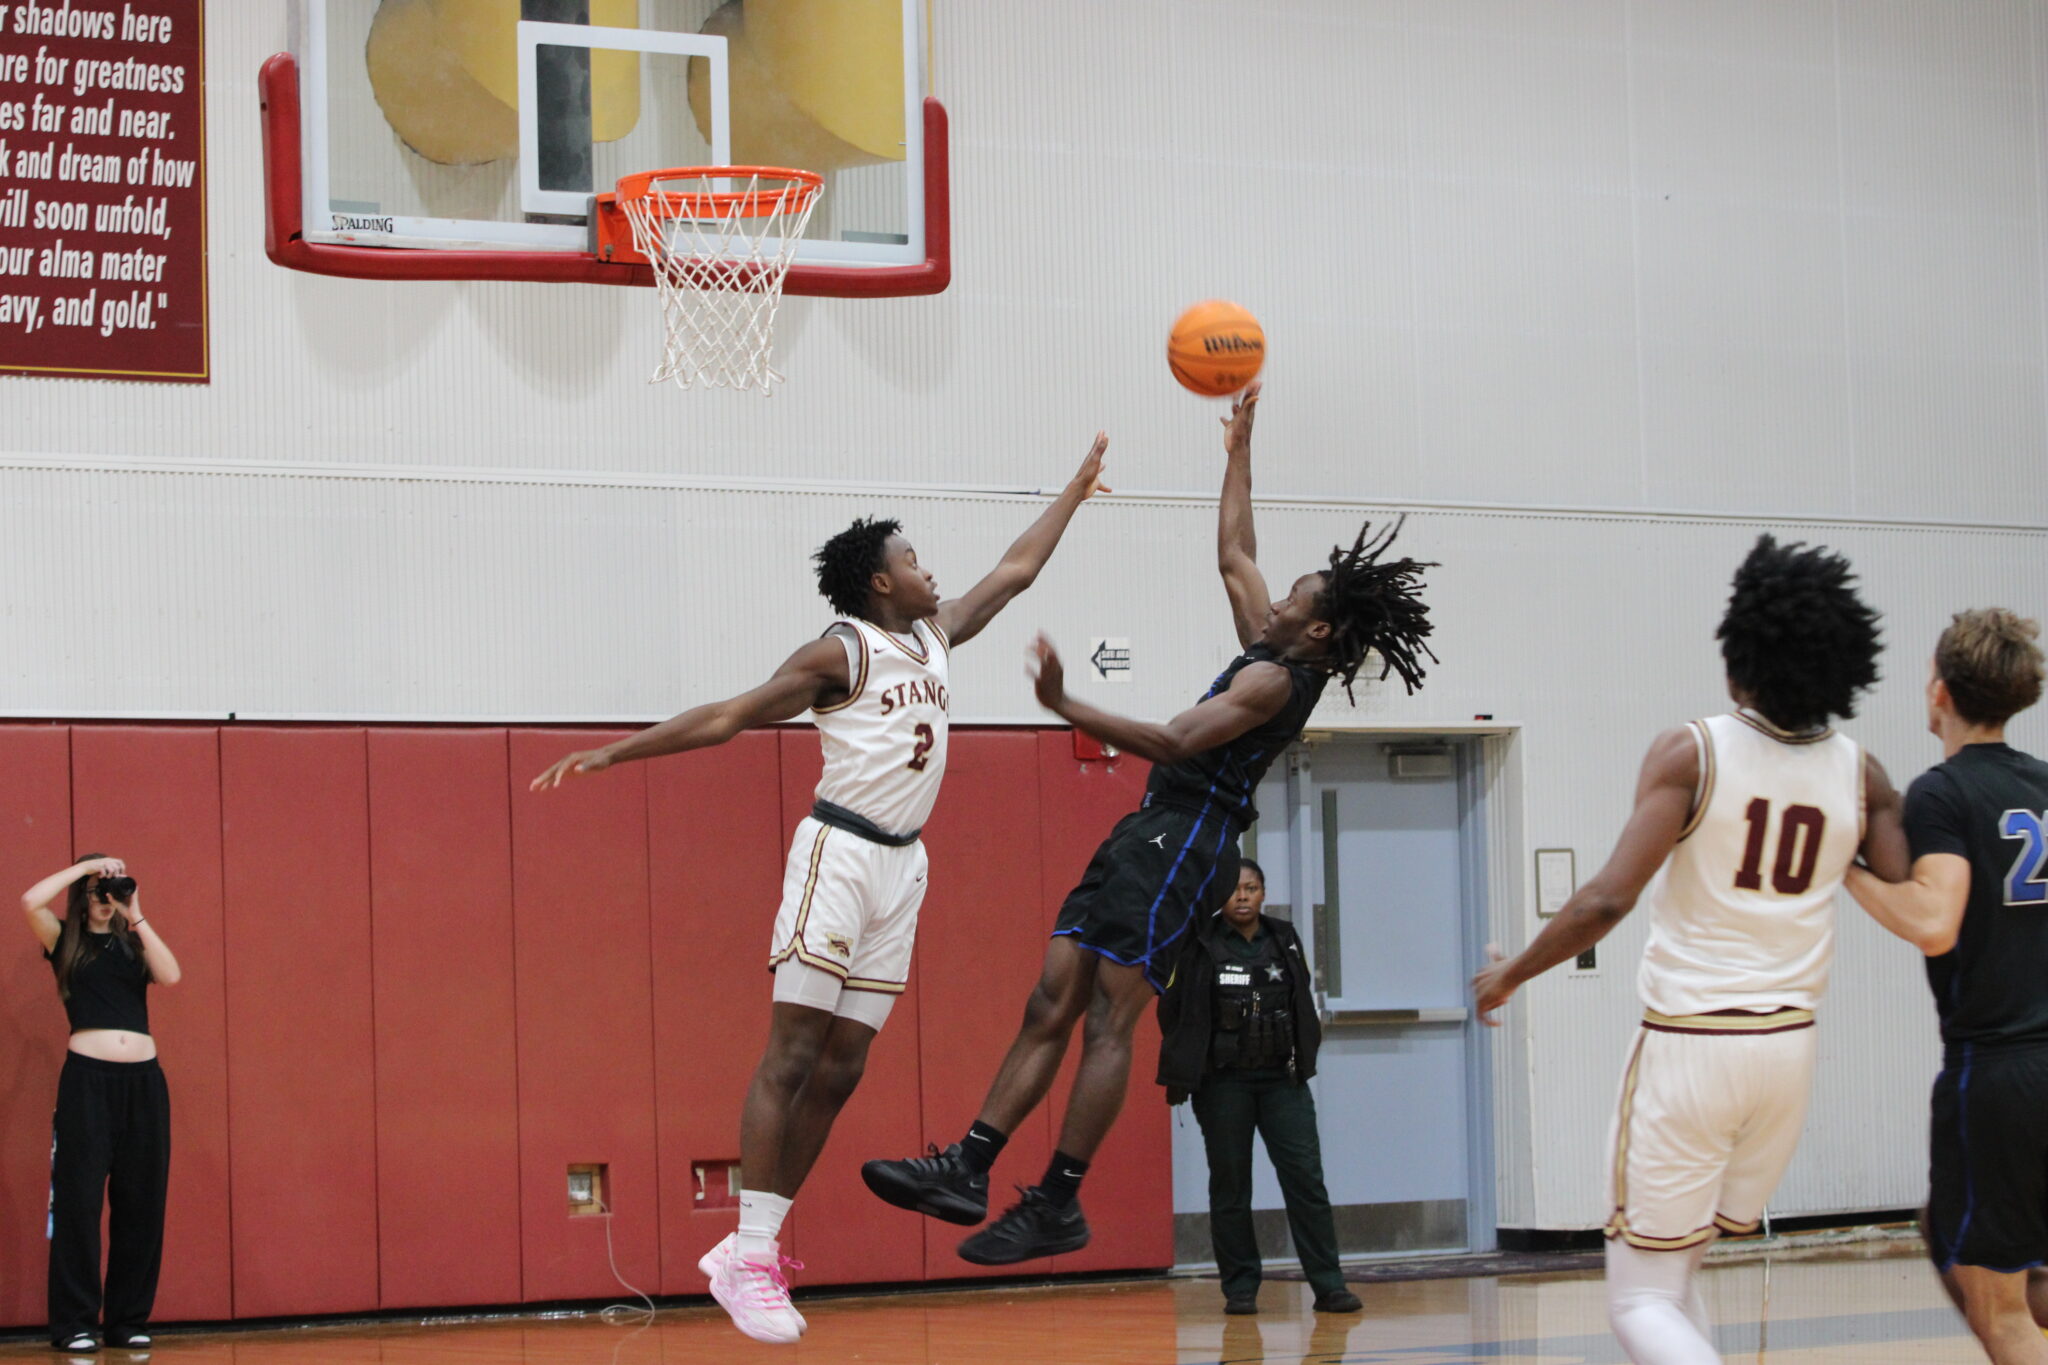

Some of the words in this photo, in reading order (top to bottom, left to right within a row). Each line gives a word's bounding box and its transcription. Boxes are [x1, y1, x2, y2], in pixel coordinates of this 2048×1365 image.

[13, 0, 115, 40] shadows
[121, 3, 172, 44] here
[35, 45, 69, 86] for
[73, 56, 184, 96] greatness
[0, 101, 26, 131] es
[32, 93, 66, 133] far
[70, 97, 114, 136] and
[118, 108, 175, 140] near.
[15, 141, 54, 180] and
[59, 142, 121, 184] dream
[127, 147, 149, 185] of
[151, 148, 195, 188] how
[0, 188, 29, 228] ill
[33, 200, 88, 231] soon
[95, 195, 172, 241] unfold,
[331, 214, 393, 233] SPALDING
[39, 239, 94, 279] alma
[100, 247, 167, 282] mater
[0, 294, 44, 333] avy,
[52, 288, 96, 327] and
[100, 290, 168, 337] gold."
[907, 722, 934, 771] 2
[1732, 796, 1827, 895] 10
[1219, 974, 1250, 985] SHERIFF
